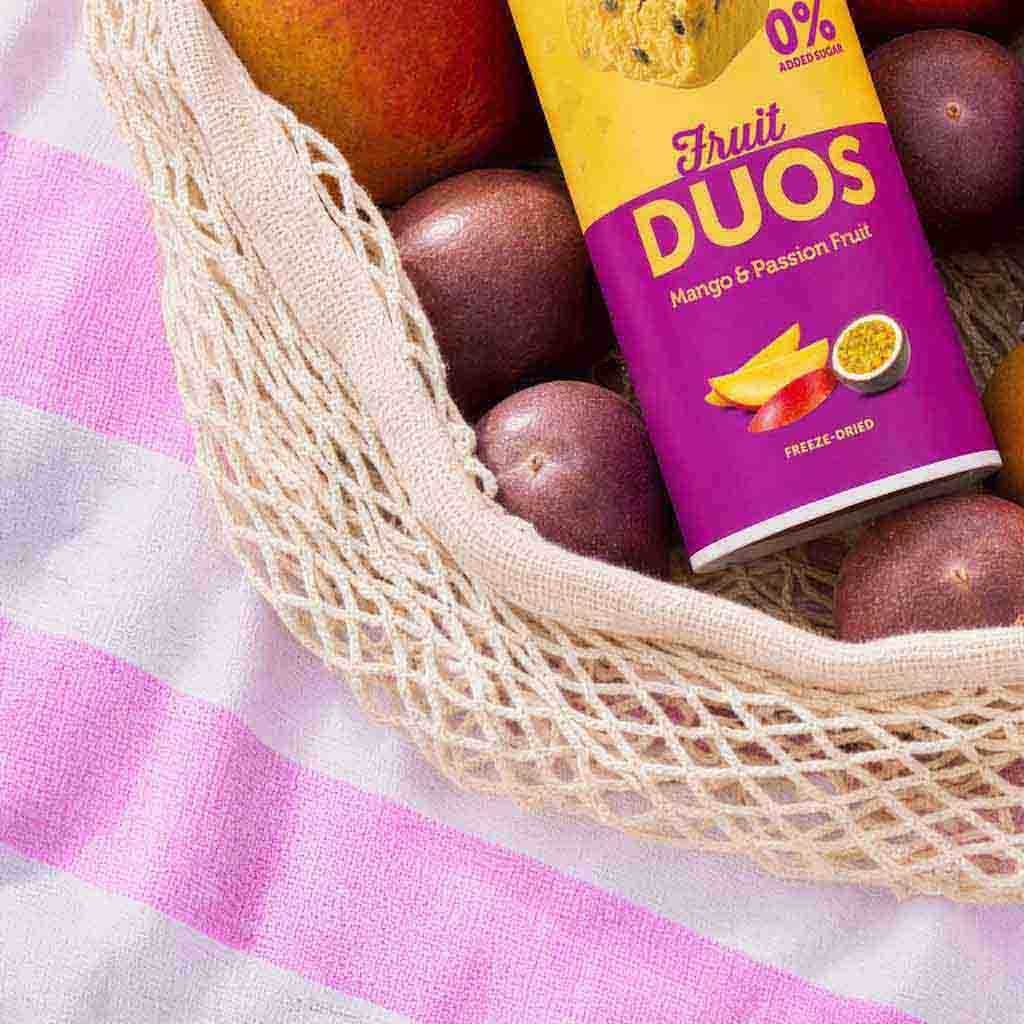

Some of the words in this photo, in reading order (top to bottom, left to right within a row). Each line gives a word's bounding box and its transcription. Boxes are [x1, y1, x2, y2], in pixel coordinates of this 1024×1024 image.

[779, 52, 814, 73] ADDED
[814, 42, 844, 61] SUGAR
[672, 102, 786, 176] Fruit
[632, 134, 877, 279] DUOS
[670, 274, 734, 308] Mango
[735, 265, 750, 284] &
[751, 239, 831, 278] Passion
[828, 222, 873, 252] Fruit
[783, 417, 875, 460] FREEZE-DRIED
